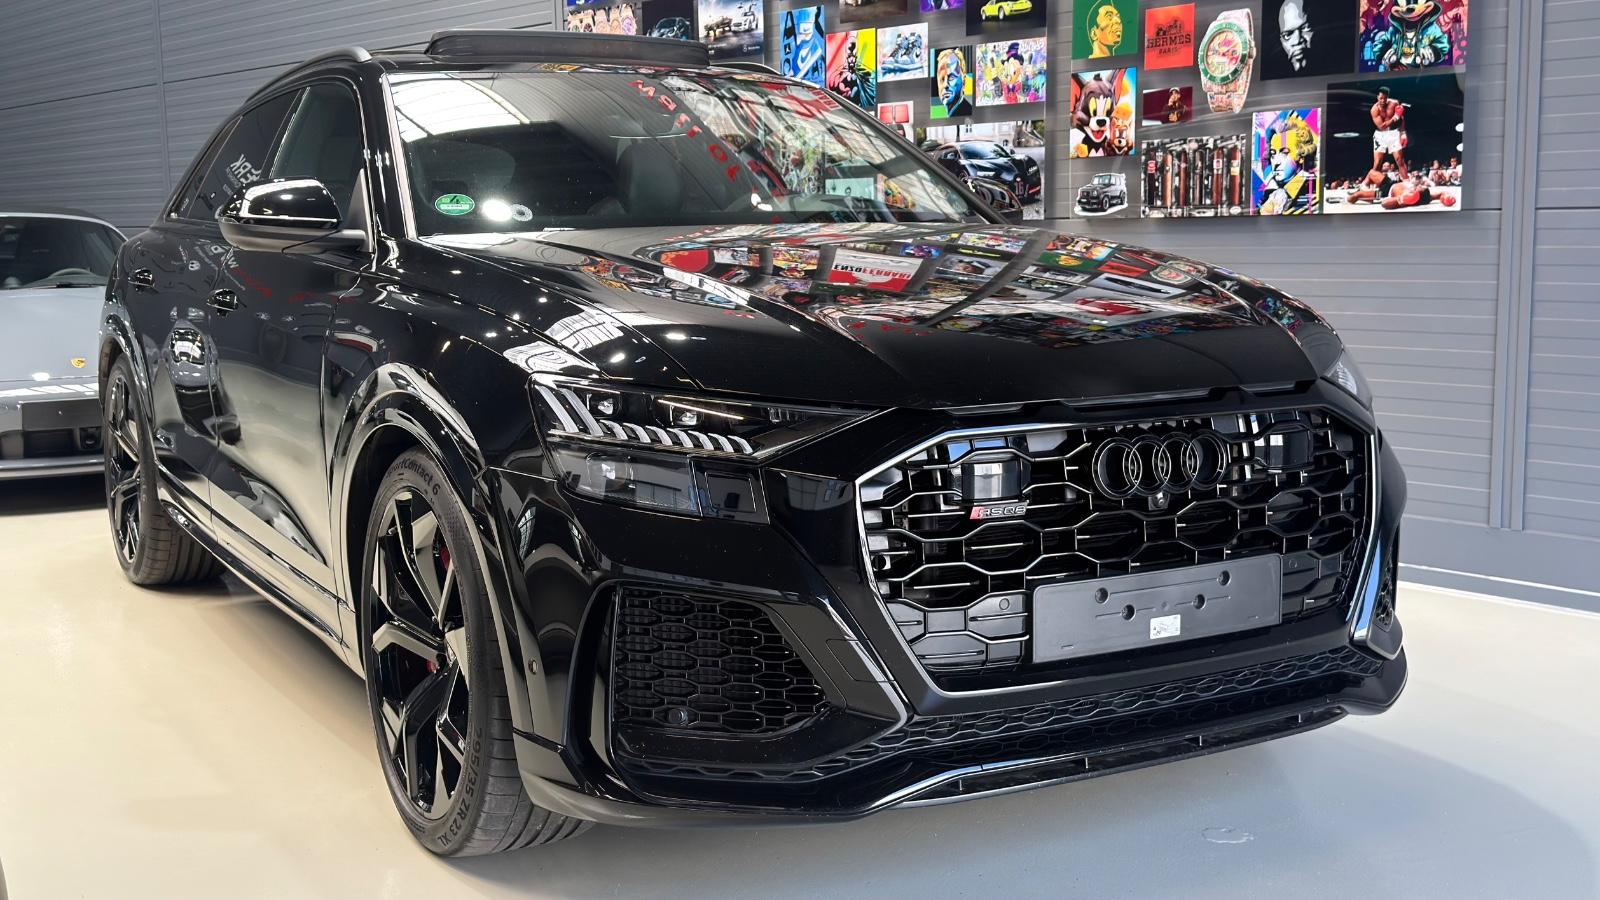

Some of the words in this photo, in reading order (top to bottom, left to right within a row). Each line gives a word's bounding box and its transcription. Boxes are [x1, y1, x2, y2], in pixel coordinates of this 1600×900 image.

[432, 483, 441, 496] 6
[465, 727, 482, 797] 295/35
[456, 798, 470, 821] ZR
[449, 817, 461, 837] 23
[437, 832, 452, 847] XL
